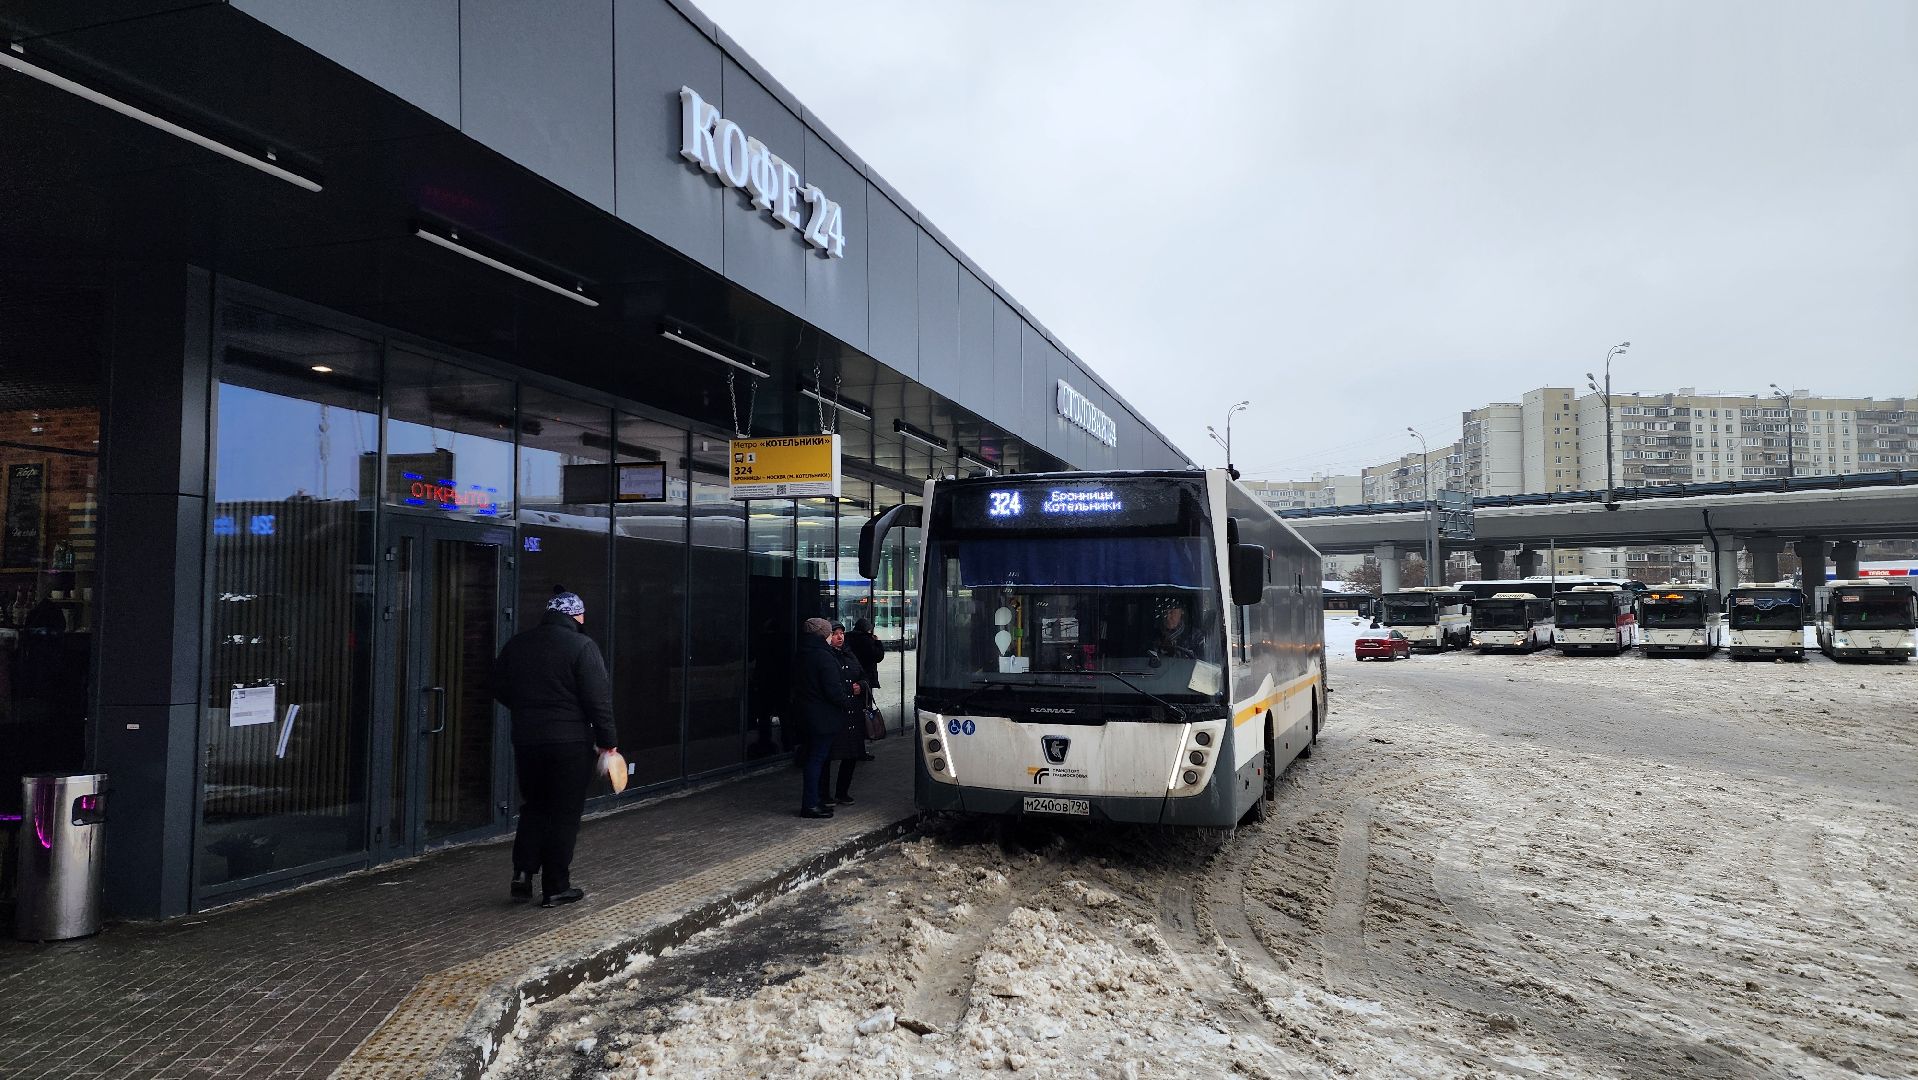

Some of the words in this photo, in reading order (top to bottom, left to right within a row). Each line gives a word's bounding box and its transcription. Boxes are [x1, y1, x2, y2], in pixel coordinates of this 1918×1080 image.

[680, 85, 800, 229] КОФЕ
[804, 183, 845, 258] 24
[1060, 383, 1107, 441] СТОЛОВАЯ
[733, 441, 758, 449] Метро
[759, 437, 831, 448] «КОТЕЛЬНИКИ»
[748, 454, 754, 462] 1
[734, 466, 753, 475] 324
[411, 481, 490, 509] ОТКРЫТО
[1051, 490, 1114, 501] Бронницы
[989, 491, 1022, 516] 324
[1044, 501, 1122, 512] Котельники
